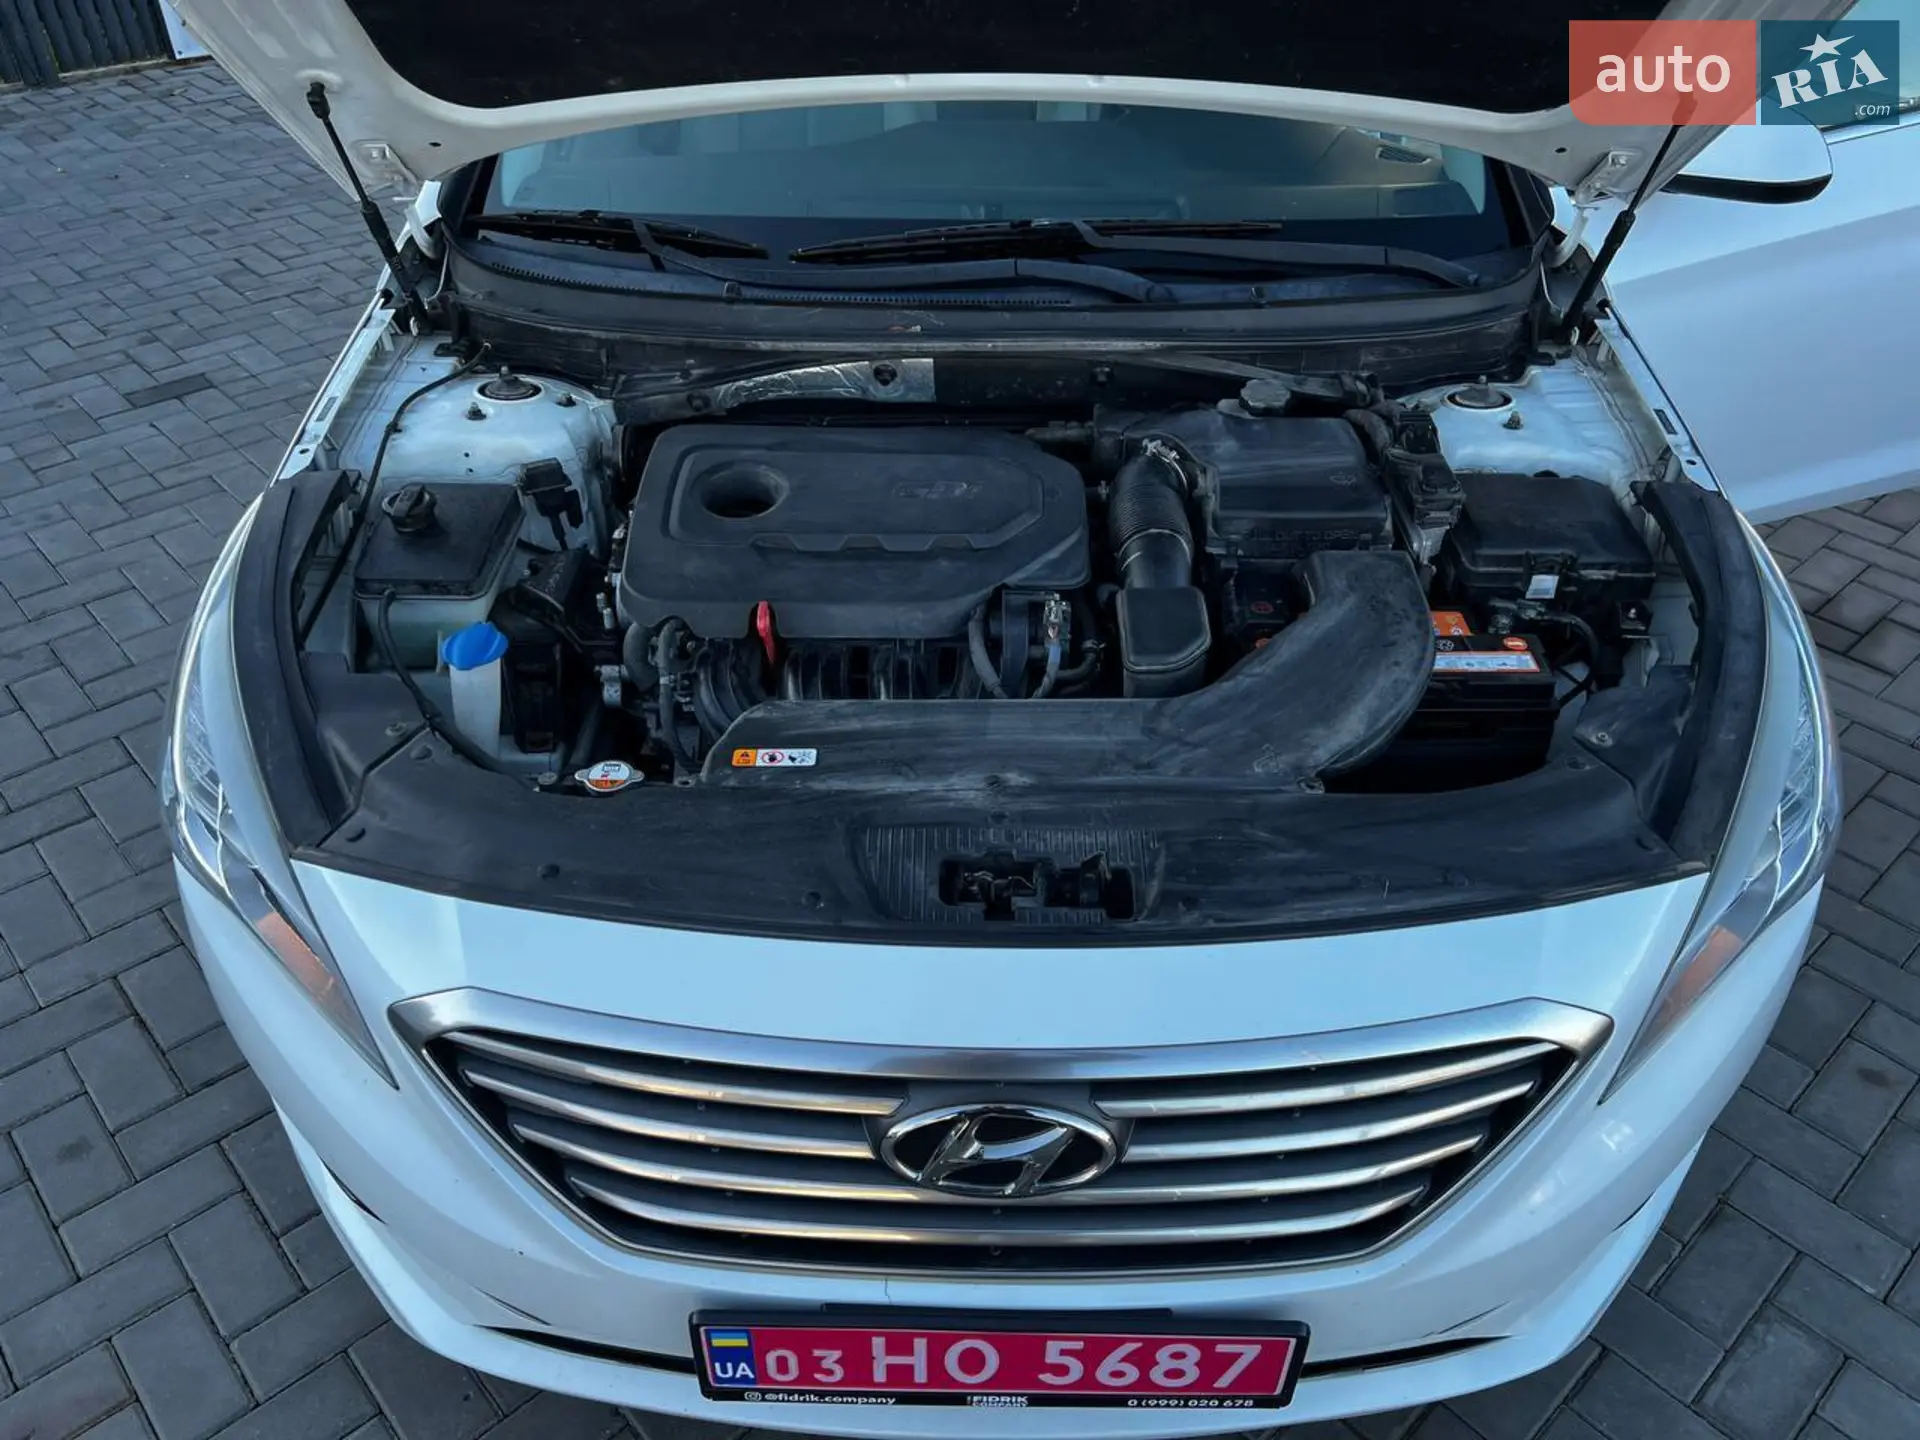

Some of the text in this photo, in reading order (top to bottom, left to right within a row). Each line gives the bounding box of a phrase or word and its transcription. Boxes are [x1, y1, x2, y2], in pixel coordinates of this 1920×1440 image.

[766, 1336, 1262, 1388] 03 HO 5687
[715, 1361, 754, 1379] UA
[765, 1393, 895, 1405] @fidrik.company
[972, 1395, 1029, 1404] FIDRIK
[1188, 1399, 1219, 1407] 020
